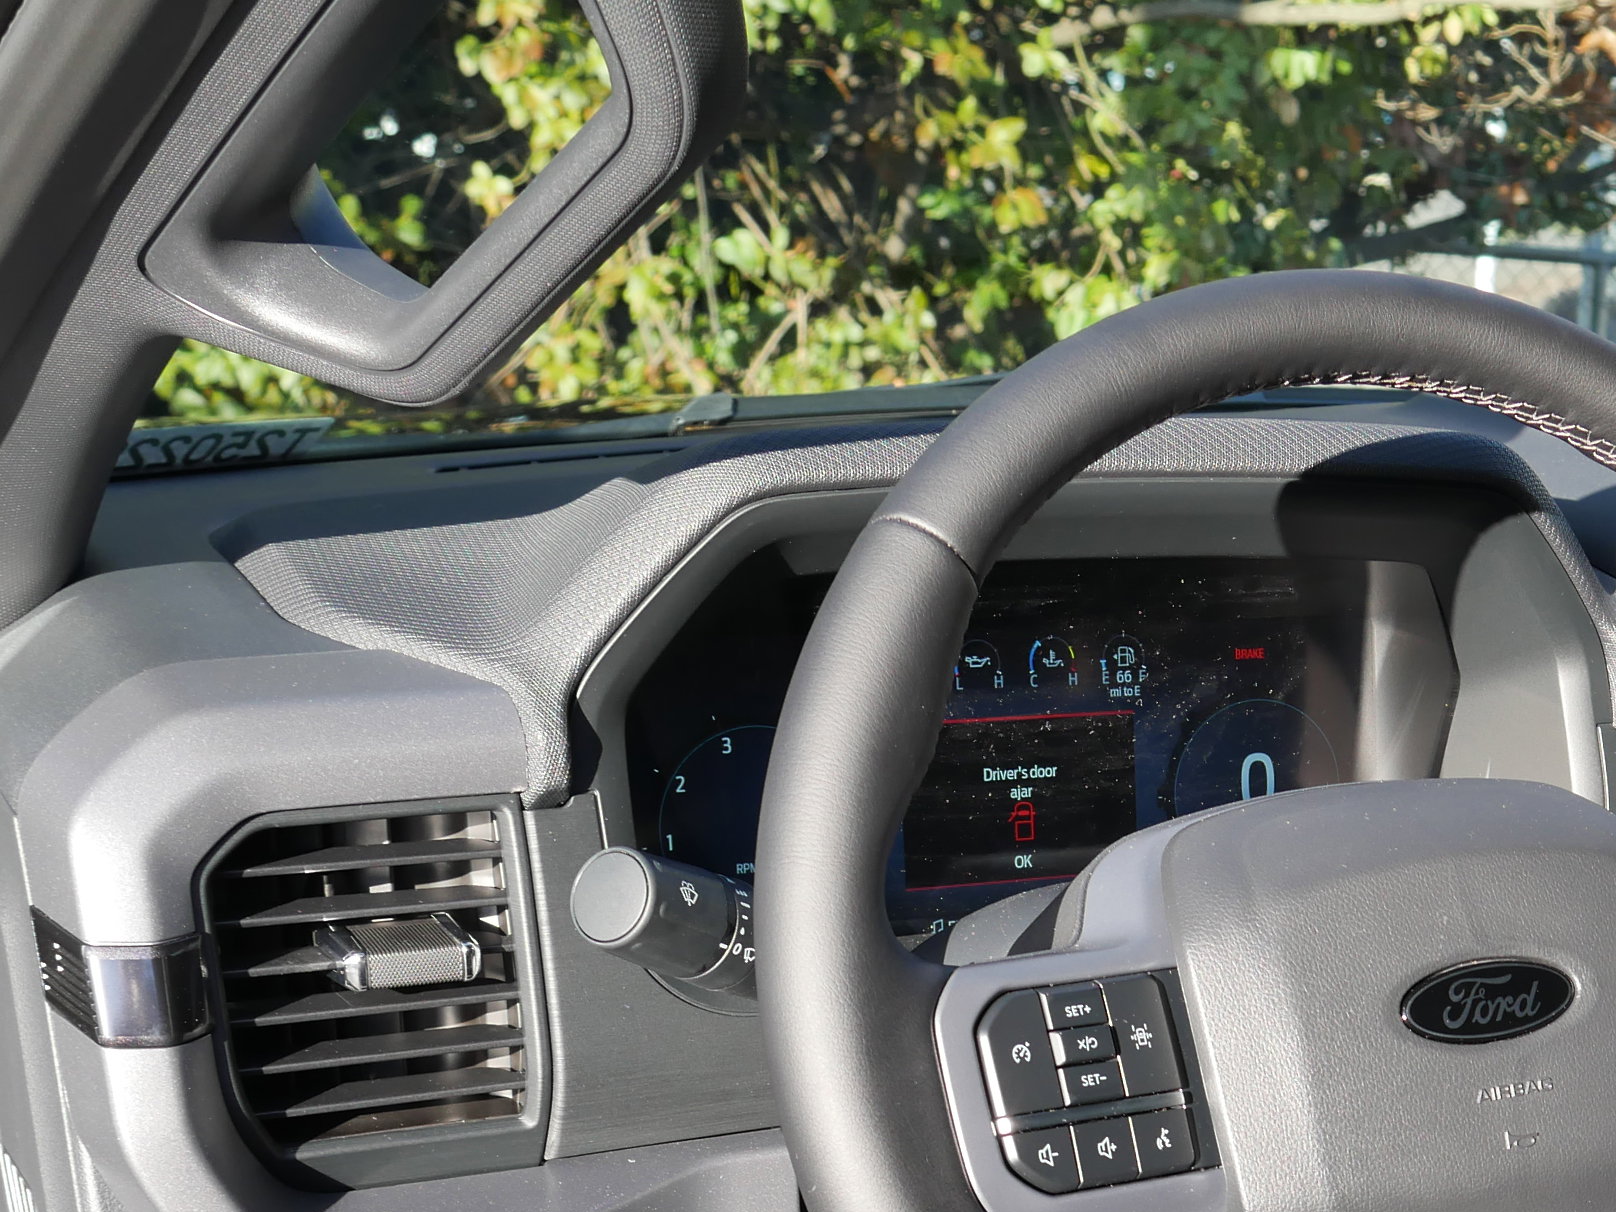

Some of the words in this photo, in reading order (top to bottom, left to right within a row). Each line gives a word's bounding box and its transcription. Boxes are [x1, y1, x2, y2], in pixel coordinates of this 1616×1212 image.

[1234, 647, 1265, 660] BRAKE
[994, 674, 1004, 688] H
[1030, 674, 1039, 688] C
[1068, 672, 1078, 686] H
[1102, 671, 1110, 684] E
[1116, 670, 1132, 683] 66
[1109, 686, 1122, 698] mi
[1123, 686, 1133, 697] to
[1134, 685, 1141, 696] E
[721, 736, 733, 755] 3
[983, 766, 1028, 782] Driver's
[1029, 764, 1058, 779] door
[1241, 752, 1275, 801] 0
[675, 775, 686, 793] 2
[1010, 785, 1033, 801] ajar
[666, 834, 674, 851] 1
[1014, 854, 1033, 869] OK
[1442, 973, 1542, 1030] Ford
[1064, 1003, 1092, 1018] SET+
[1476, 1077, 1554, 1104] AIRBAG
